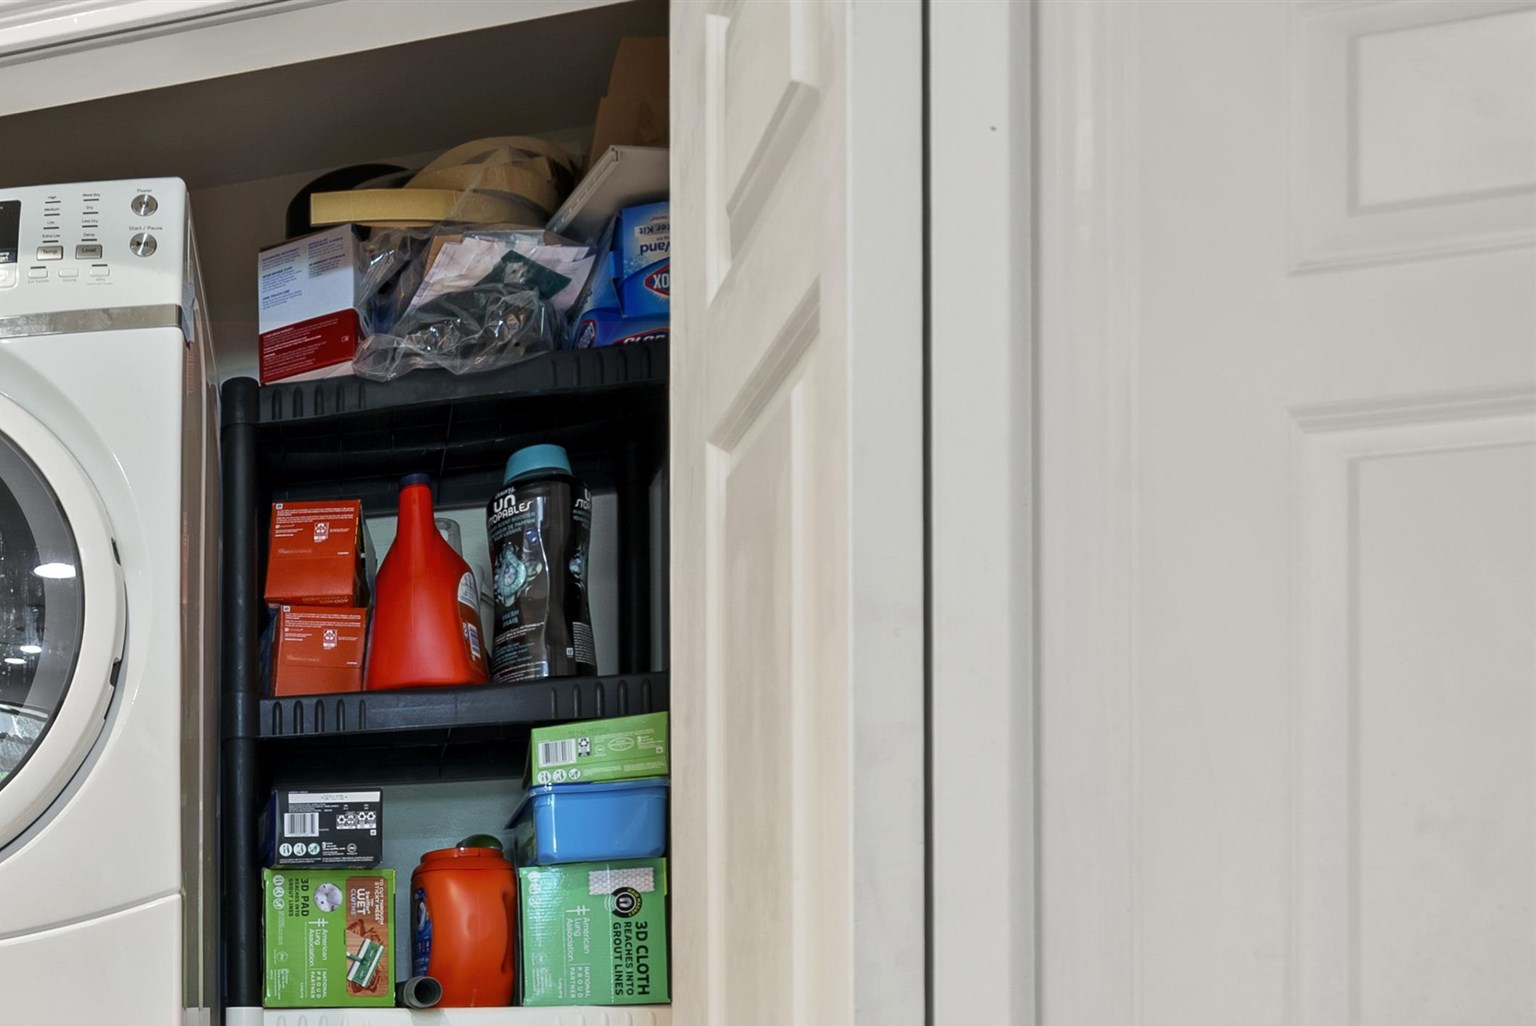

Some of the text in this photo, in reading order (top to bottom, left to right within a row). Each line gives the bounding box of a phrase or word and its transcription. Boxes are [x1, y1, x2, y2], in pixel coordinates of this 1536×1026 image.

[301, 878, 309, 917] 3D PAD
[357, 888, 366, 915] WET
[566, 919, 574, 962] Association
[574, 918, 582, 937] Lung
[612, 922, 624, 996] GROUT LINES
[624, 922, 634, 996] REACHES INTO
[635, 921, 650, 995] 3D CLOTH
